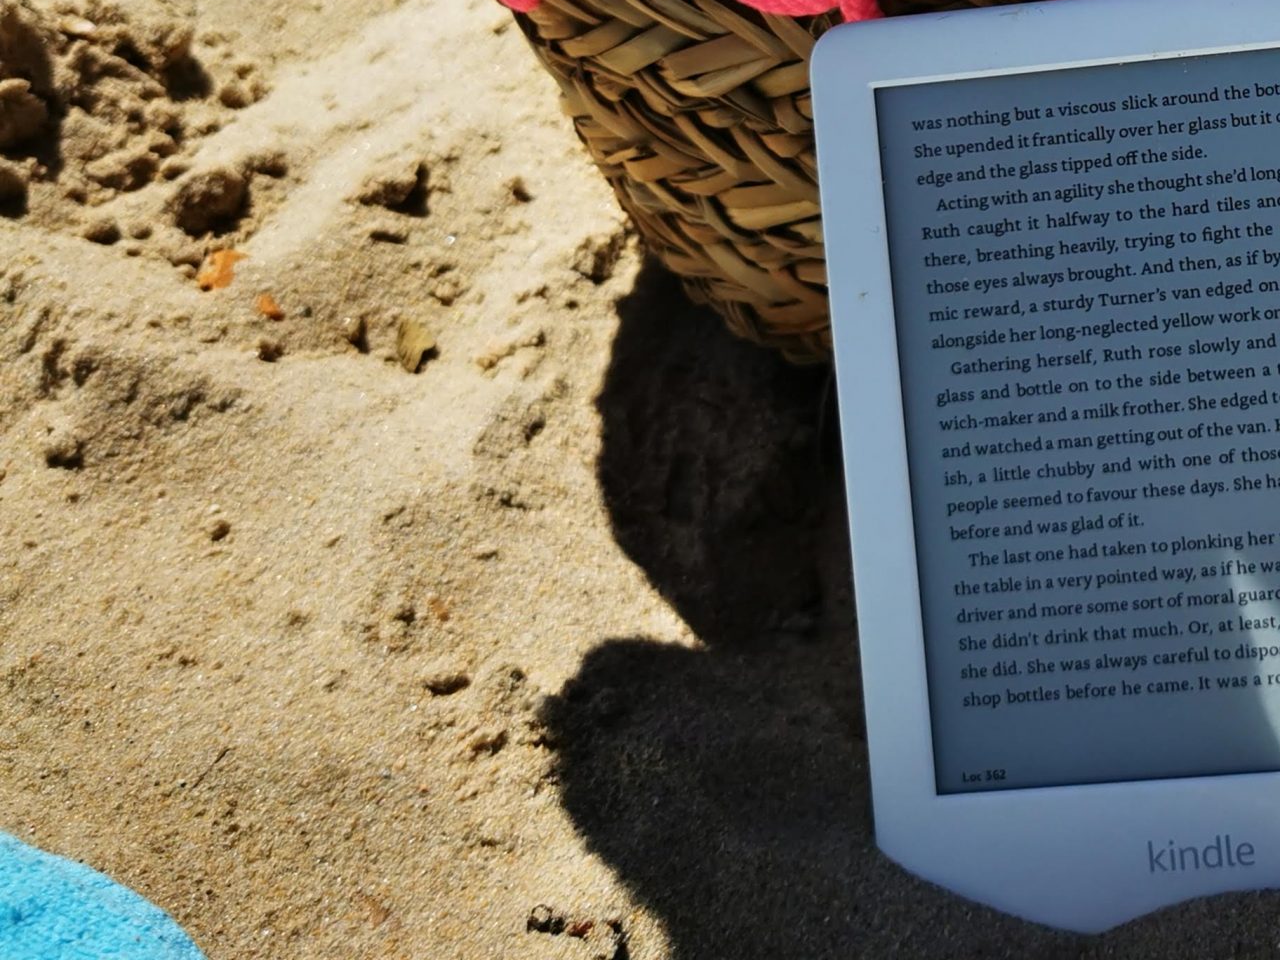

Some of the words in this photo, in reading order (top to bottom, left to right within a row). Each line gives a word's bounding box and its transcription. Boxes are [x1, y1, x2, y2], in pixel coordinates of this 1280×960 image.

[910, 117, 943, 132] was
[945, 109, 1012, 129] nothing
[1012, 105, 1042, 122] but
[1044, 106, 1056, 119] a
[1056, 100, 1117, 117] viscous
[1120, 92, 1159, 111] slick
[1161, 85, 1220, 107] around
[1222, 84, 1251, 101] the
[912, 142, 943, 159] She
[944, 133, 1015, 159] upended
[1016, 133, 1031, 149] it
[1030, 124, 1116, 148] frantically
[1117, 124, 1154, 139] over
[1155, 119, 1185, 136] her
[1187, 115, 1228, 136] glass
[1229, 111, 1258, 128] but
[1258, 109, 1273, 126] it
[915, 169, 953, 189] edge
[955, 163, 987, 182] and
[988, 162, 1016, 179] the
[1018, 159, 1059, 180] glass
[1060, 151, 1114, 175] tipped
[1115, 148, 1139, 167] off
[1139, 147, 1168, 165] the
[1170, 143, 1208, 162] side.
[920, 221, 961, 241] Ruth
[966, 217, 1023, 238] caught
[1026, 215, 1041, 231] it
[1044, 210, 1111, 229] halfway
[1114, 209, 1134, 222] to
[1137, 203, 1166, 220] the
[1170, 197, 1211, 217] hard
[1215, 195, 1251, 213] tiles
[922, 251, 972, 268] there,
[974, 242, 1056, 263] breathing
[1057, 235, 1119, 256] heavily,
[1123, 231, 1176, 252] trying
[1178, 231, 1197, 244] to
[1201, 223, 1242, 245] fight
[1245, 221, 1274, 238] the
[928, 305, 959, 323] mic
[962, 298, 1026, 320] reward,
[1028, 301, 1039, 314] a
[1042, 292, 1095, 313] sturdy
[1170, 286, 1202, 301] van
[1204, 277, 1254, 300] edged
[1257, 279, 1280, 293] on
[930, 328, 1007, 351] alongside
[1008, 326, 1037, 343] her
[1038, 314, 1160, 342] long-neglected
[1160, 311, 1215, 334] yellow
[1217, 305, 1262, 325] work
[949, 355, 1032, 376] Gathering
[1035, 347, 1098, 369] herself,
[1101, 344, 1143, 363] Ruth
[1147, 344, 1182, 359] rose
[1187, 335, 1241, 356] slowly
[1245, 331, 1278, 350] and
[935, 387, 975, 408] glass
[979, 382, 1011, 401] and
[1014, 378, 1063, 398] bottle
[1067, 380, 1090, 393] on
[1094, 378, 1113, 392] to
[1115, 372, 1144, 390] the
[1148, 368, 1182, 387] side
[1185, 366, 1257, 384] between
[1261, 365, 1272, 377] a
[937, 409, 1034, 432] wich-maker
[1036, 405, 1068, 424] and
[1070, 408, 1081, 421] a
[1082, 401, 1120, 420] milk
[1121, 397, 1185, 417] frother.
[1187, 394, 1217, 412] She
[1219, 388, 1269, 411] edged
[943, 469, 973, 487] ish,
[977, 471, 987, 484] a
[992, 464, 1031, 483] little
[1035, 459, 1096, 480] chubby
[1101, 455, 1133, 474] and
[1137, 452, 1177, 471] with
[1181, 454, 1212, 468] one
[1217, 447, 1236, 465] of
[948, 523, 1000, 542] before
[1002, 518, 1034, 537] and
[1036, 520, 1068, 534] was
[1070, 513, 1105, 536] glad
[1107, 512, 1126, 529] of
[1127, 511, 1145, 528] it.
[967, 550, 1000, 568] The
[1002, 548, 1032, 565] last
[1034, 548, 1065, 563] one
[1067, 541, 1099, 561] had
[1100, 540, 1147, 558] taken
[1149, 540, 1169, 554] to
[1170, 532, 1245, 556] plonking
[1246, 529, 1276, 547] her
[955, 606, 1005, 624] driver
[1007, 601, 1038, 621] and
[1040, 602, 1083, 618] more
[1086, 599, 1129, 615] some
[1131, 595, 1164, 612] sort
[1166, 591, 1184, 609] of
[1186, 587, 1235, 608] moral
[959, 662, 988, 680] she
[991, 659, 1023, 678] did.
[1026, 657, 1056, 675] She
[1059, 658, 1091, 672] was
[1094, 652, 1148, 672] always
[1152, 645, 1210, 666] careful
[1212, 647, 1232, 661] to
[962, 771, 982, 783] Loc
[985, 769, 1006, 781] 362
[1147, 834, 1256, 873] kindle
